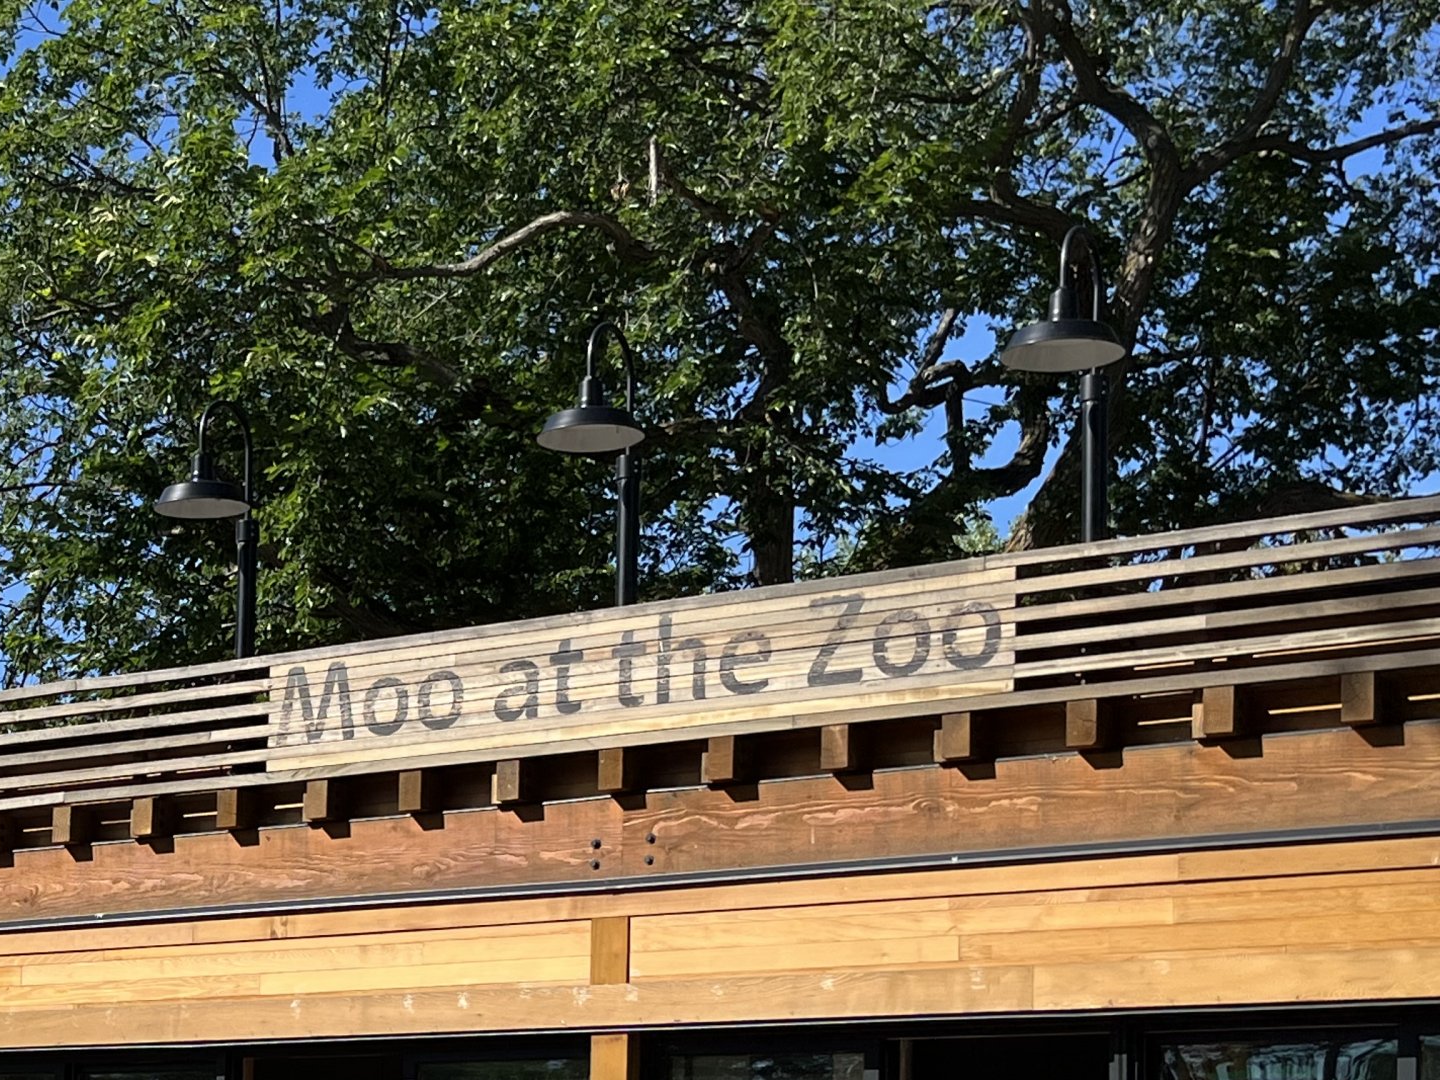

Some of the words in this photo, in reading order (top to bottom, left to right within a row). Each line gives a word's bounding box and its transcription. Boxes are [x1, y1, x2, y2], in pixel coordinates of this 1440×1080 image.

[277, 660, 464, 746] Moo
[494, 640, 583, 722] at
[612, 614, 771, 708] the
[807, 592, 1002, 687] Zoo
